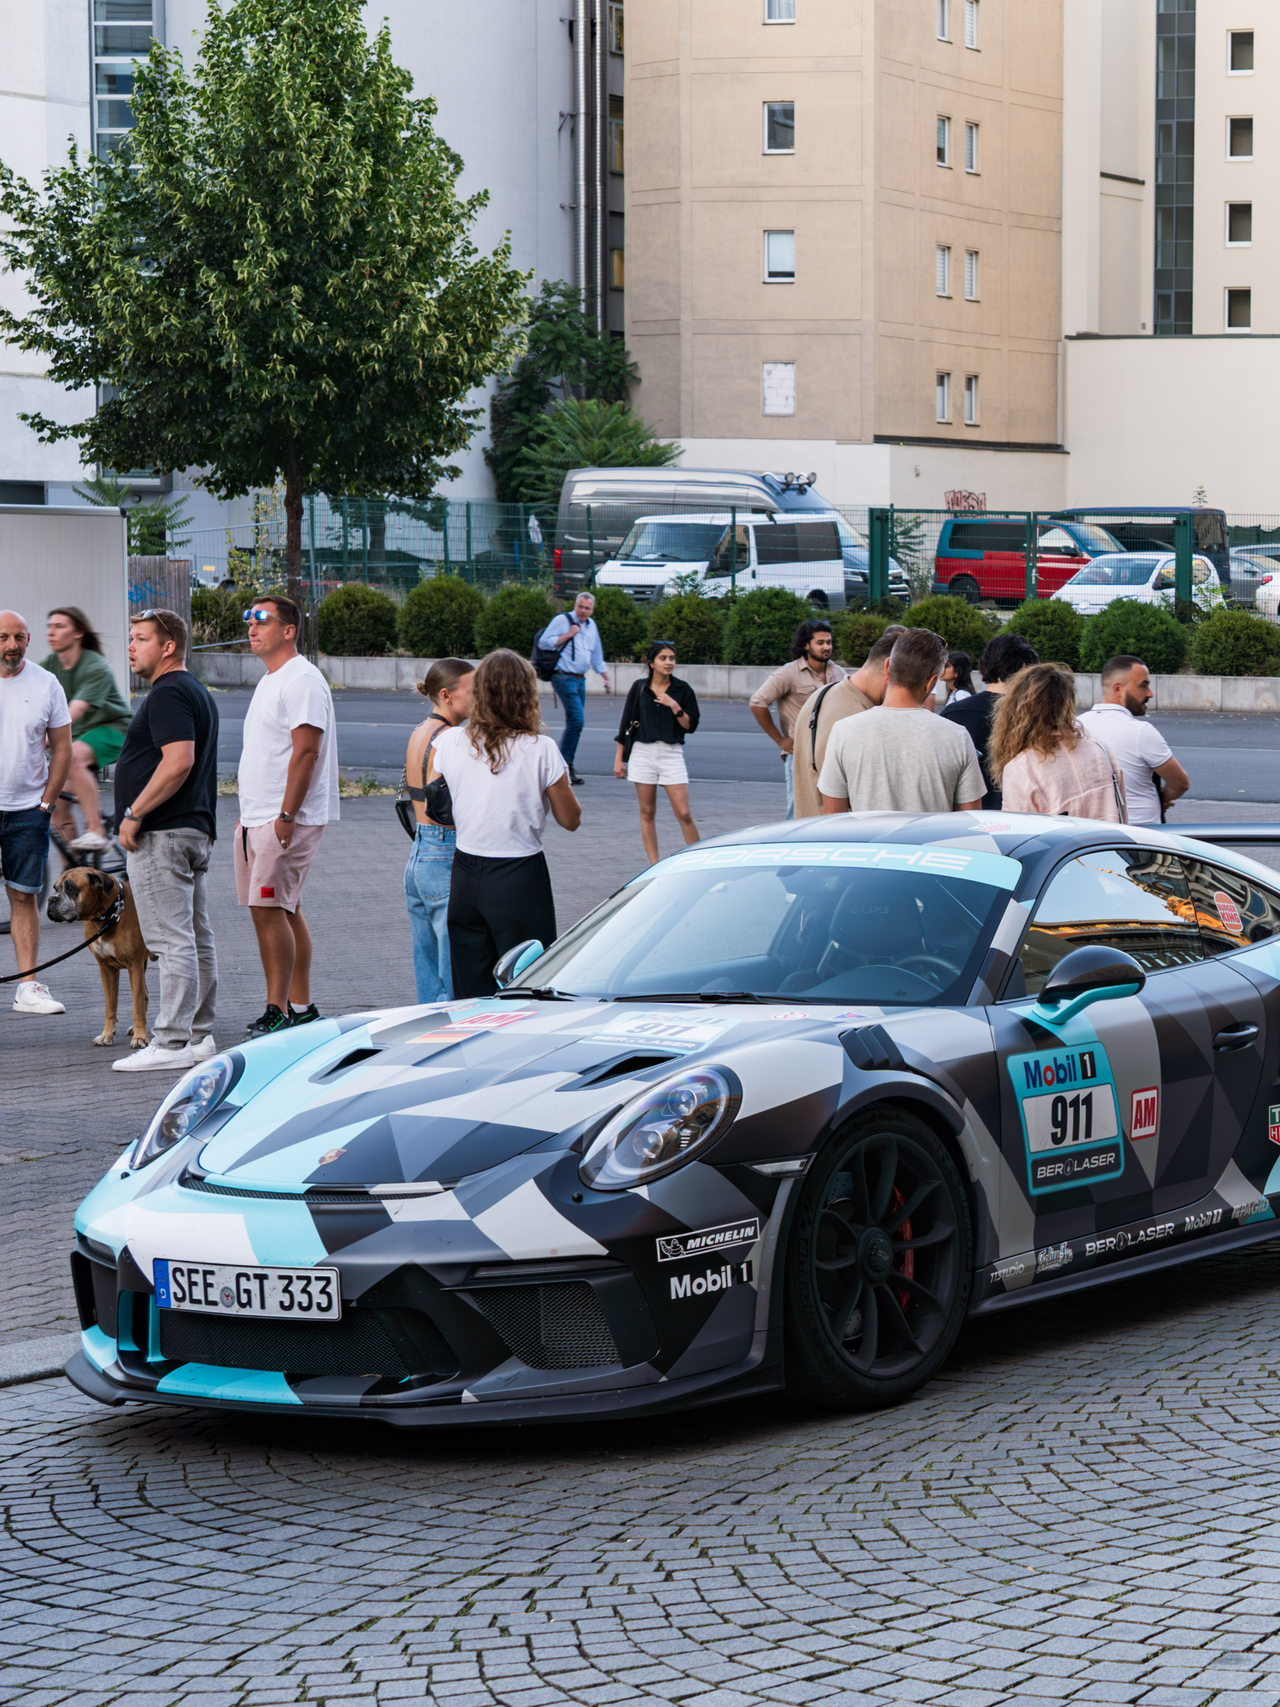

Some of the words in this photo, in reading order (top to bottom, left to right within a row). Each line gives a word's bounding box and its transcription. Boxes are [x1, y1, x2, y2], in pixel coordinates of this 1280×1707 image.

[667, 847, 973, 871] PORSCHE
[1219, 912, 1241, 924] KING
[625, 1022, 699, 1037] 911
[1023, 1054, 1078, 1090] Mobil
[1050, 1091, 1093, 1146] 911
[1133, 1096, 1156, 1130] AM
[1184, 1210, 1213, 1232] Mobil
[1212, 1208, 1223, 1224] 1
[1238, 1199, 1270, 1218] PAGID
[686, 1226, 755, 1250] MICHELIN
[159, 1288, 167, 1299] D
[172, 1266, 219, 1306] SEE
[235, 1271, 269, 1310] GT
[277, 1274, 333, 1313] 333
[670, 1264, 732, 1300] Mobil
